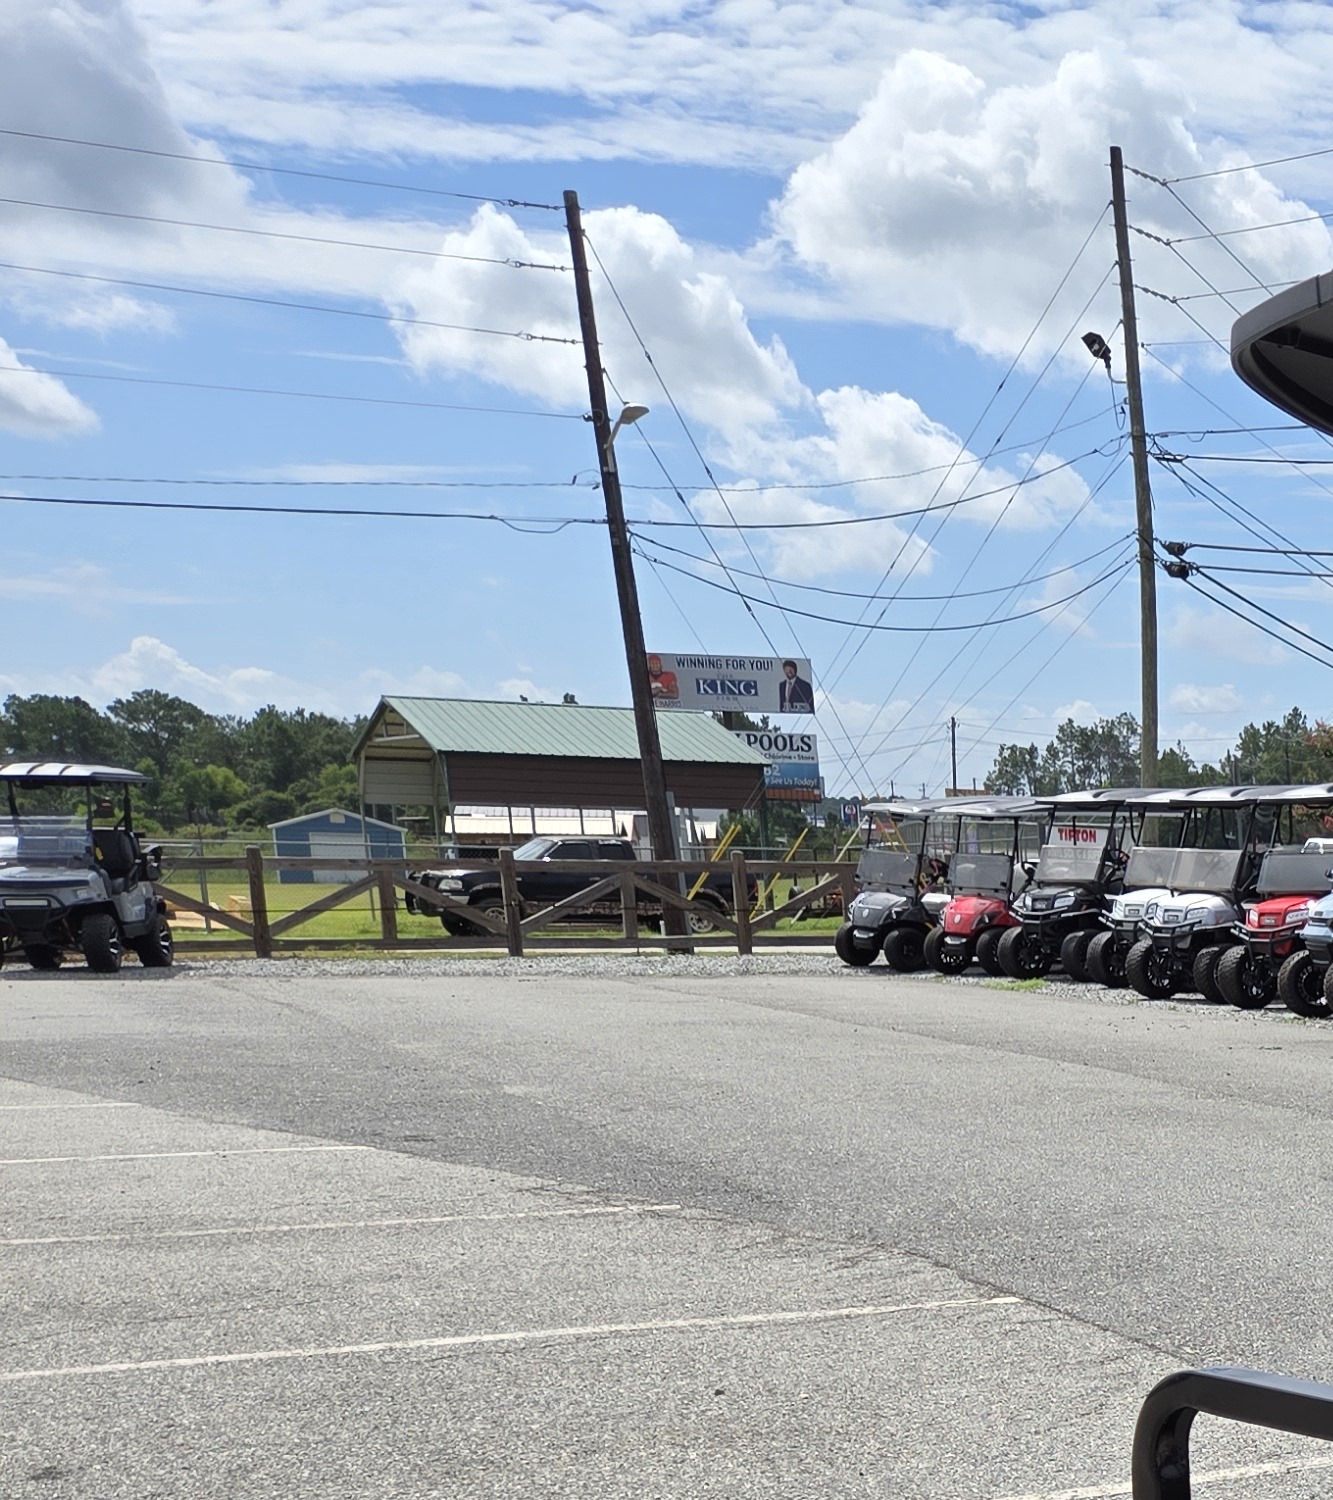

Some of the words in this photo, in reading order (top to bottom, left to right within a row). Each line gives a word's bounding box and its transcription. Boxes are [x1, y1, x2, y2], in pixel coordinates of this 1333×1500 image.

[675, 656, 723, 669] WINNING
[725, 659, 746, 671] FOR
[749, 660, 774, 672] YOU!
[698, 679, 757, 696] KING
[746, 733, 812, 753] POOLS
[783, 777, 793, 786] Us
[793, 777, 818, 788] Today!
